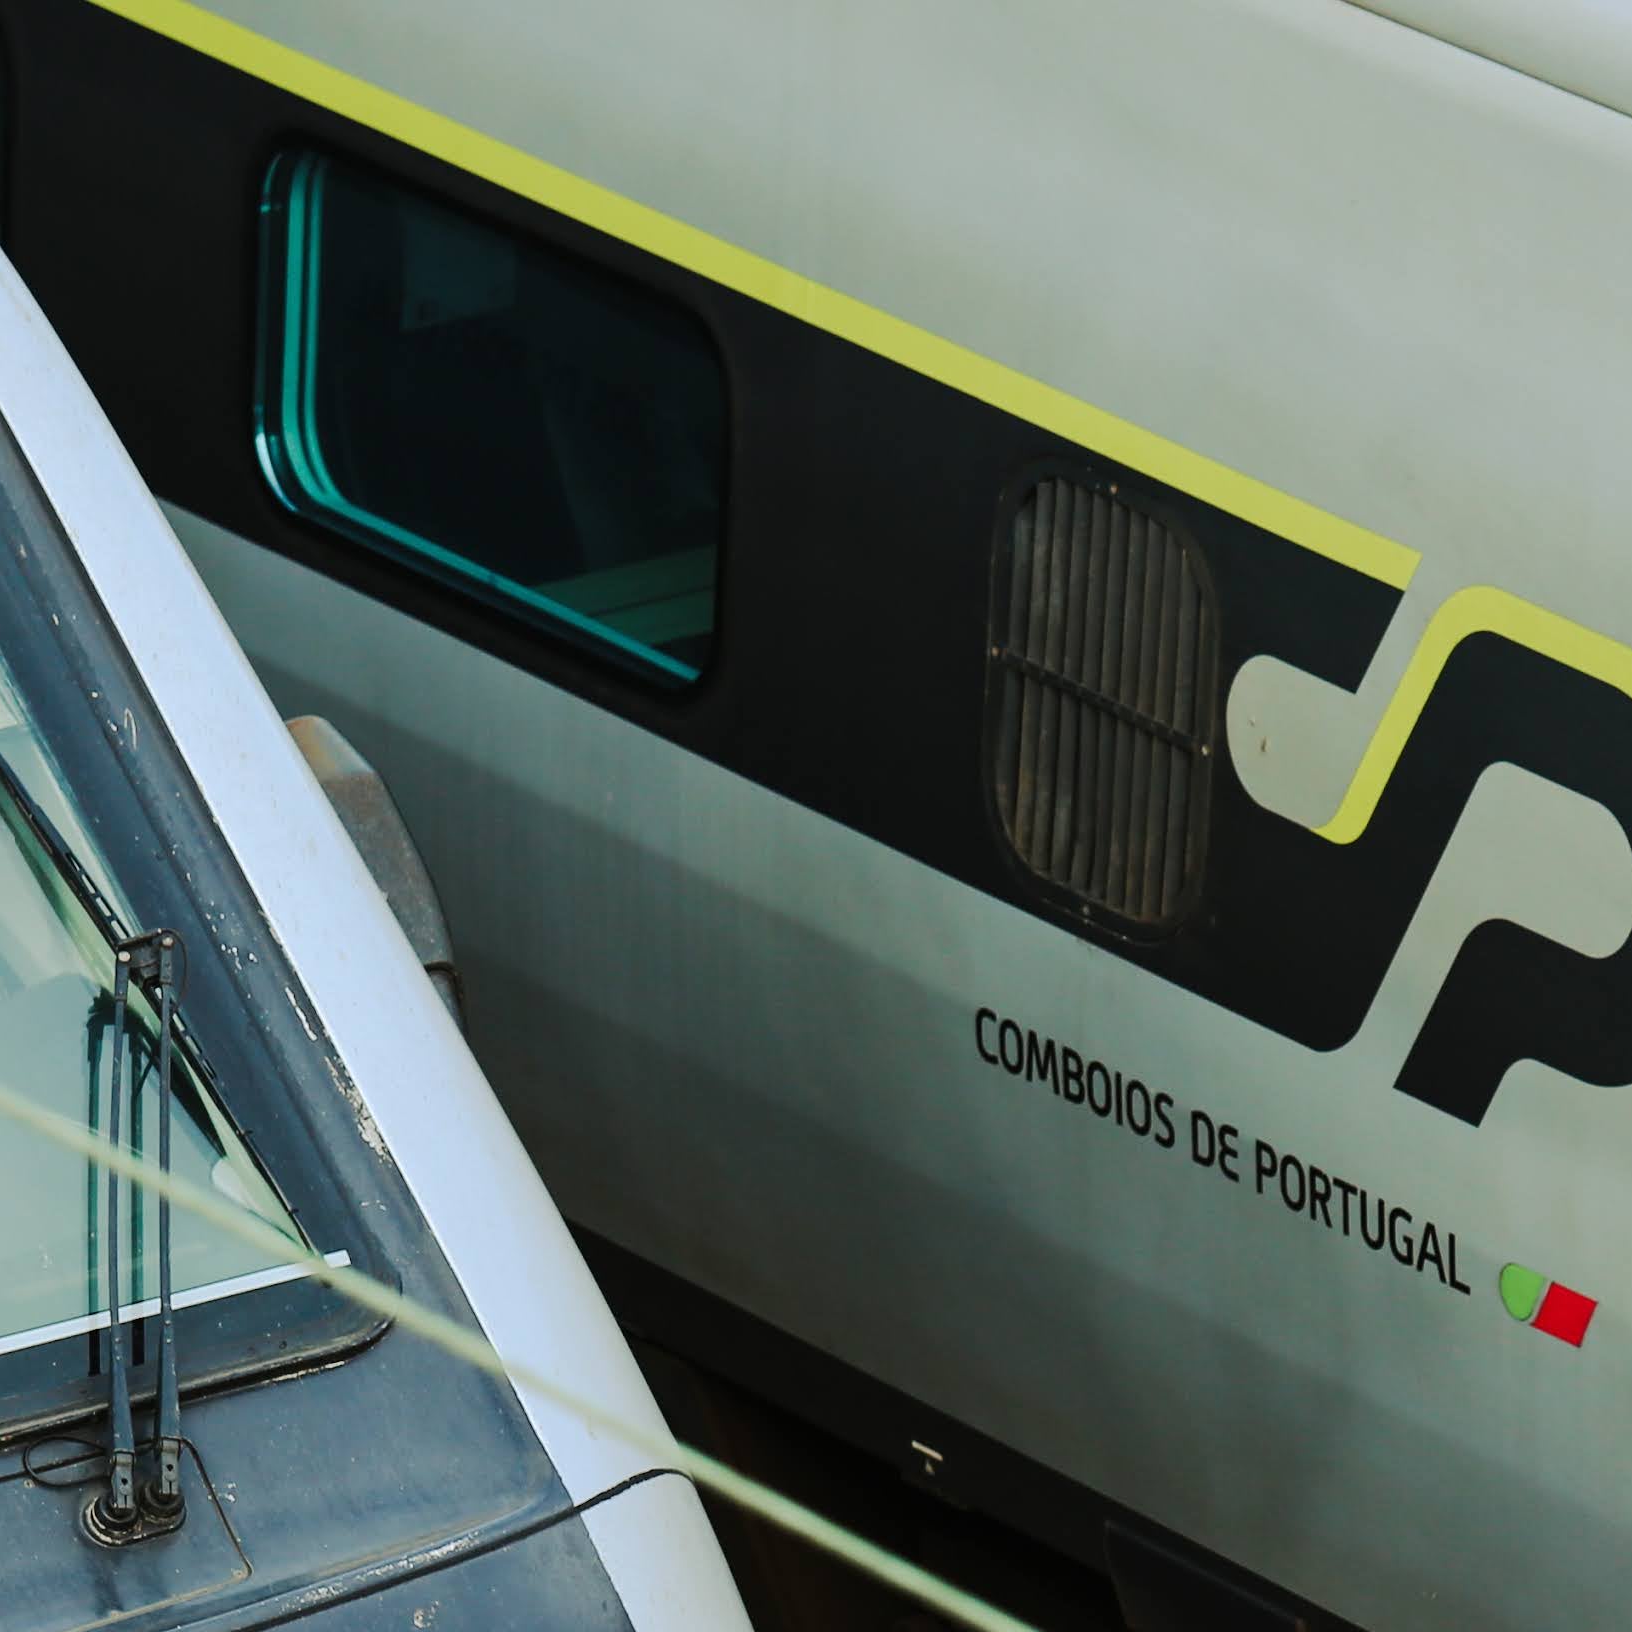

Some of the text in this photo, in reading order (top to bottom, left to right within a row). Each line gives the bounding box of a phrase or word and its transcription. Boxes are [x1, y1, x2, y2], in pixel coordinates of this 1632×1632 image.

[974, 1006, 1471, 1296] COMBOIOS DE PORTUGAL
